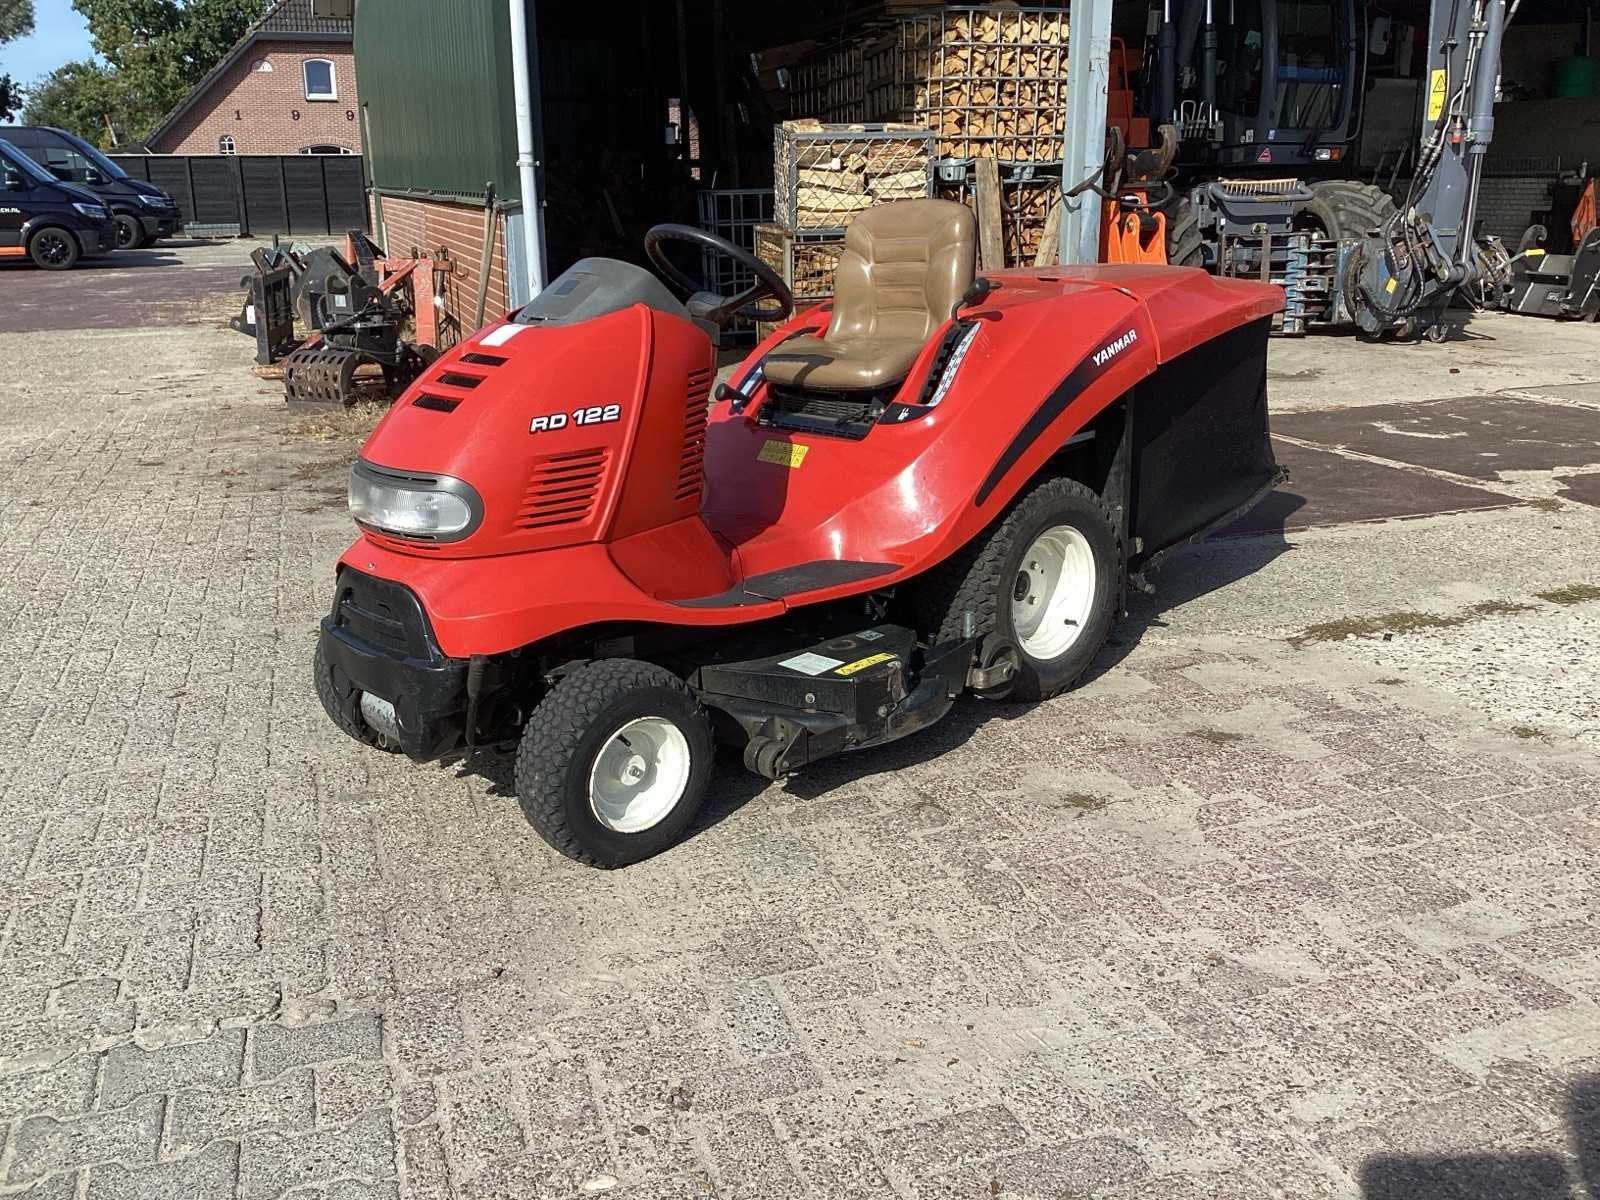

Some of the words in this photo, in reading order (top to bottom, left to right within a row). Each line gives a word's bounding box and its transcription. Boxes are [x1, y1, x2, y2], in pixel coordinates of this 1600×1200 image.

[234, 110, 242, 121] 1
[346, 110, 355, 122] 9
[1092, 328, 1137, 366] YANMAR
[530, 414, 568, 433] RD
[572, 404, 621, 426] 122
